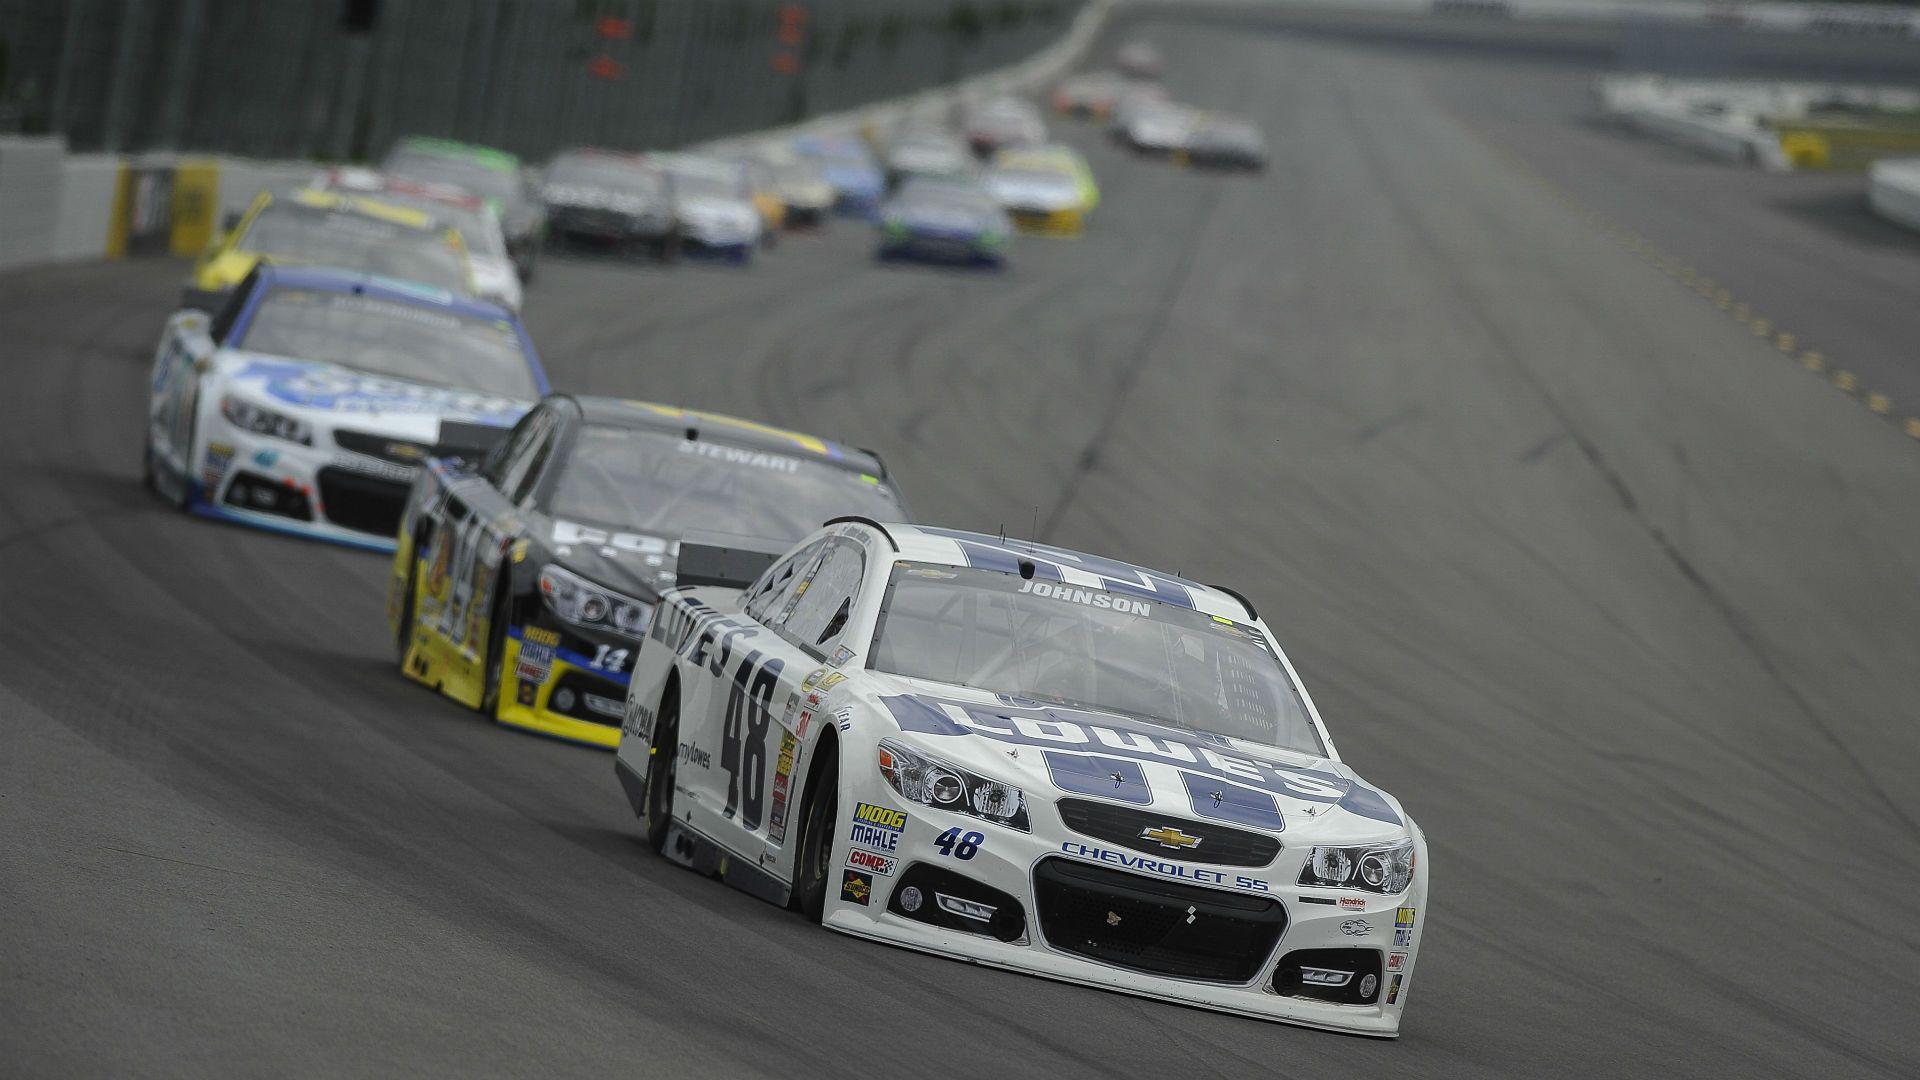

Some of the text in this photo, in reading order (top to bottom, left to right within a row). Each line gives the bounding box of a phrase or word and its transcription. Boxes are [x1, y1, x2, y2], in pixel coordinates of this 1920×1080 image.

[678, 440, 799, 473] STEWART
[1018, 581, 1150, 617] JOHNSON
[590, 644, 629, 673] 14
[679, 741, 711, 770] mylowes
[721, 649, 786, 832] 48
[938, 703, 1346, 798] LOWE'S
[856, 803, 906, 828] MOOG
[850, 824, 898, 850] MAHLE
[933, 826, 985, 860] 48
[850, 851, 884, 871] COMP
[1061, 841, 1227, 883] CHEVROLET
[1340, 897, 1366, 907] Hendrick
